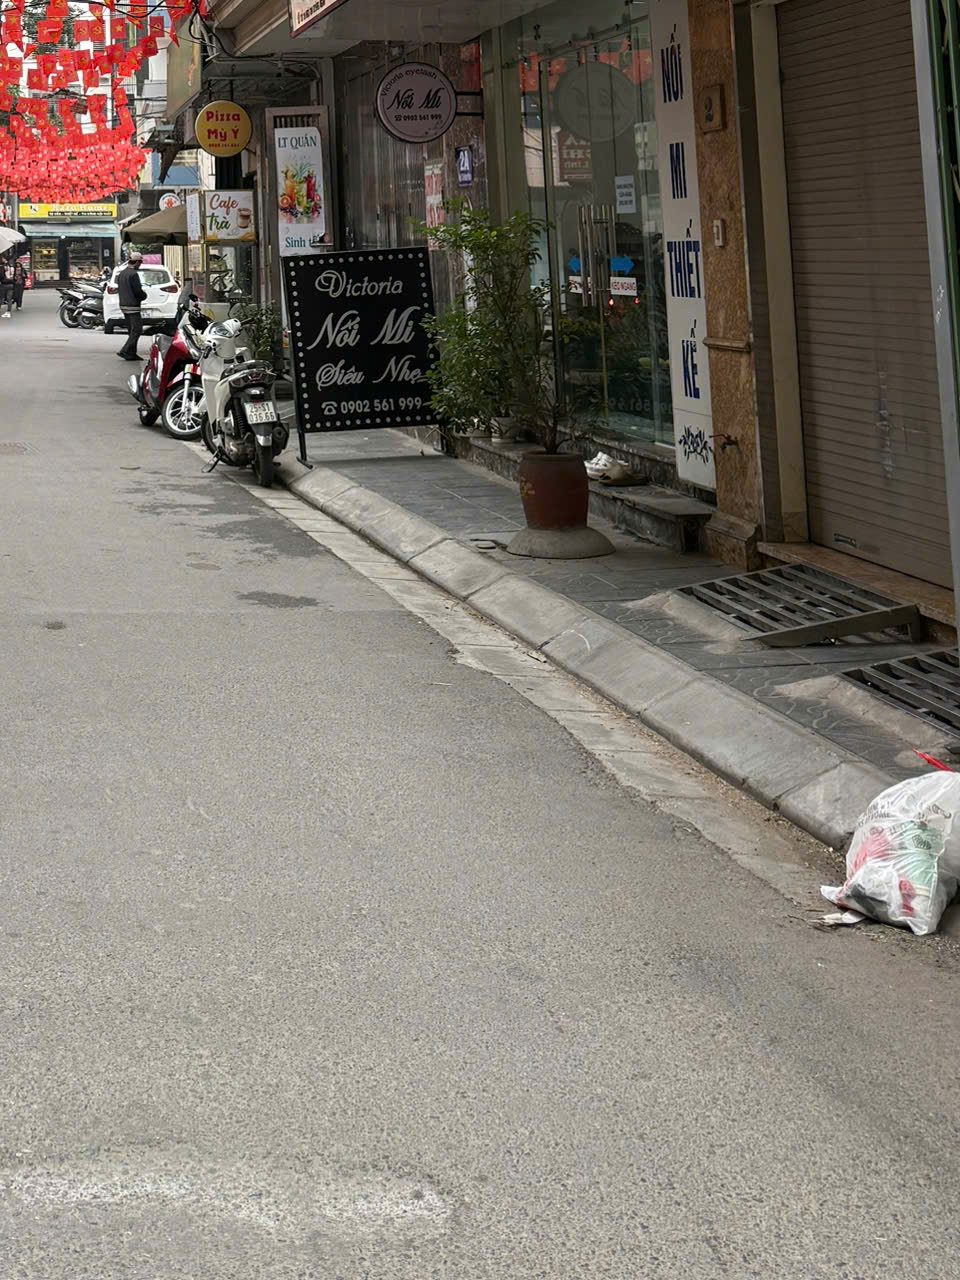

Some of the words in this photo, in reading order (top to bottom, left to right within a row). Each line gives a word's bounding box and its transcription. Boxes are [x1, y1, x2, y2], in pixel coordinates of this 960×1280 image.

[206, 110, 240, 122] Pizza
[207, 128, 227, 141] Mỳ
[232, 125, 239, 139] Ý
[278, 136, 288, 149] LT
[290, 134, 317, 150] QUÁN
[459, 150, 470, 171] 2A
[669, 142, 688, 199] MI
[210, 193, 239, 216] Cafe
[285, 236, 306, 248] Sinh
[666, 218, 701, 299] THIẾT
[315, 269, 404, 298] Victoria
[306, 310, 361, 350] Nối
[370, 305, 421, 346] Mi
[680, 319, 701, 400] KẾ
[315, 359, 366, 392] Siêu
[372, 354, 422, 384] Nhẹ
[340, 400, 371, 415] 0902
[373, 398, 394, 412] 561
[399, 396, 422, 410] 999
[248, 411, 275, 423] 036.66
